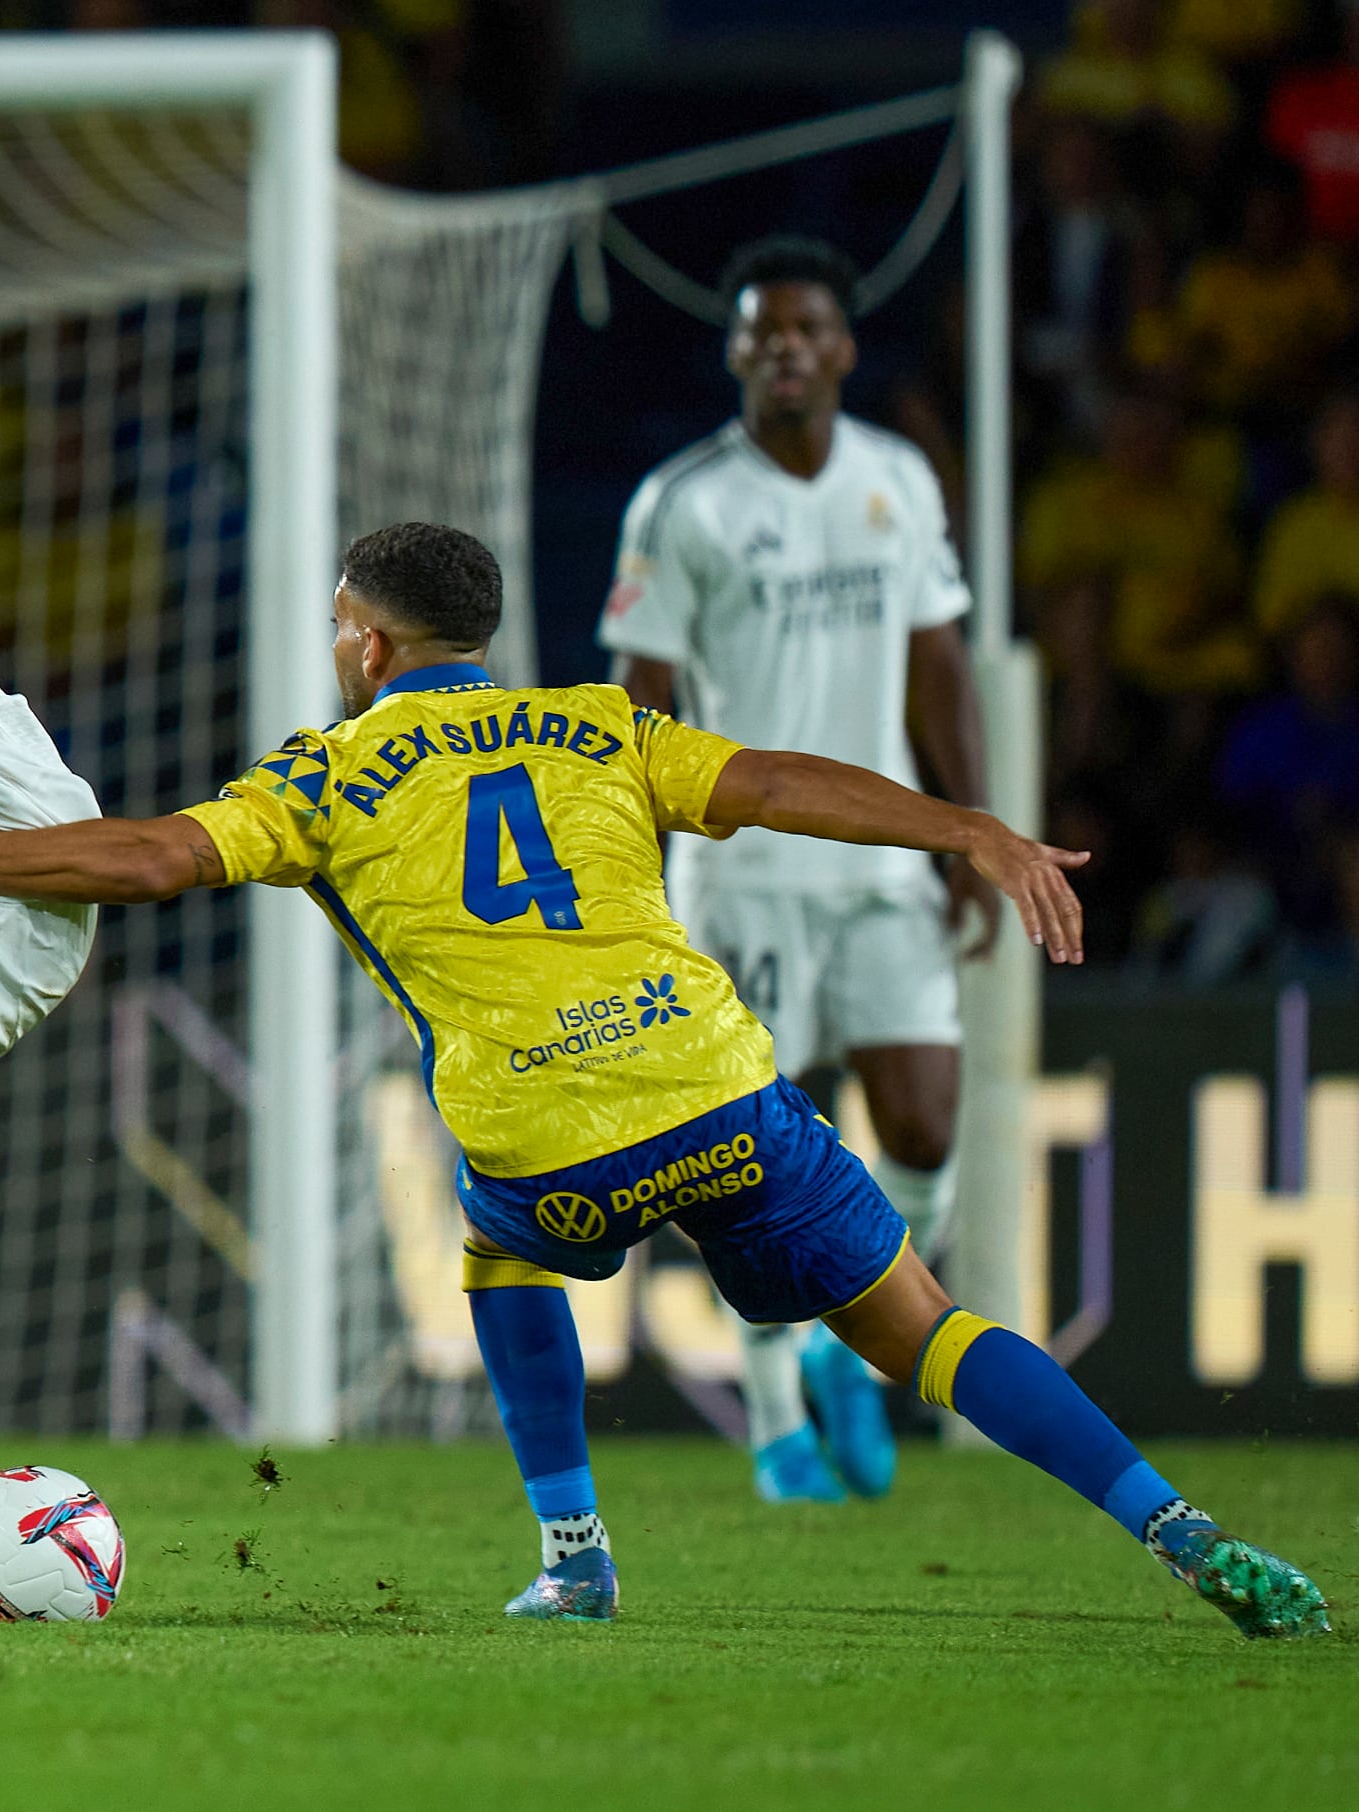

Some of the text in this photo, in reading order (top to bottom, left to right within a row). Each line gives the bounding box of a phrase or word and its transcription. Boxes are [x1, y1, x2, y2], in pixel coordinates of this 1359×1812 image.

[333, 701, 623, 818] ÁLEX SUÁREZ
[462, 762, 584, 930] 4
[556, 995, 626, 1031] Islas
[609, 1132, 755, 1214] DOMINGO
[638, 1162, 764, 1228] ALONSO
